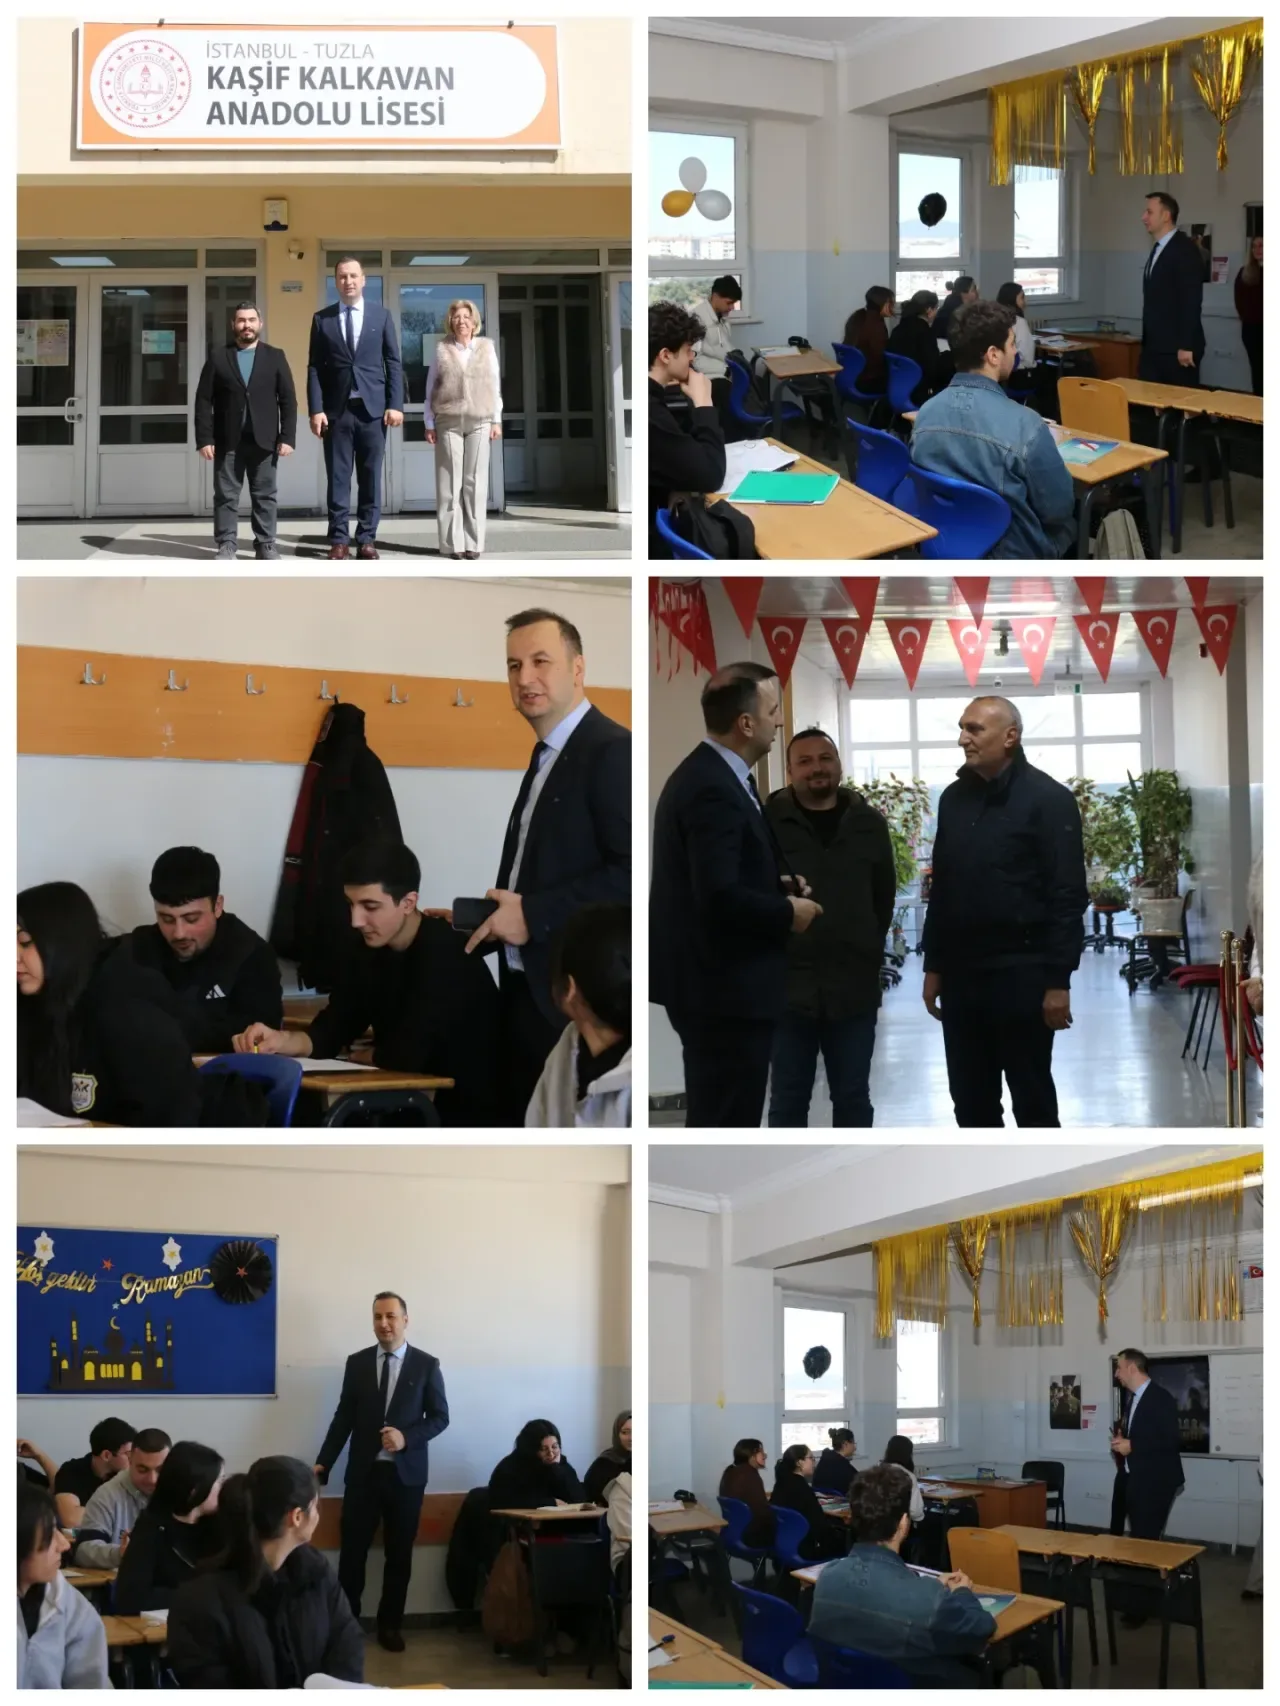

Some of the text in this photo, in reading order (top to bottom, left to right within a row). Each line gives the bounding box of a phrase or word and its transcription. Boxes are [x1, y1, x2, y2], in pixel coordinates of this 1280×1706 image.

[206, 40, 297, 60] İSTANBUL
[313, 42, 375, 60] TUZLA
[207, 61, 291, 97] KAŞİF
[299, 66, 455, 91] KALKAVAN
[206, 96, 445, 126] ANADOLU LİSESİ
[120, 1267, 214, 1305] Ramazan
